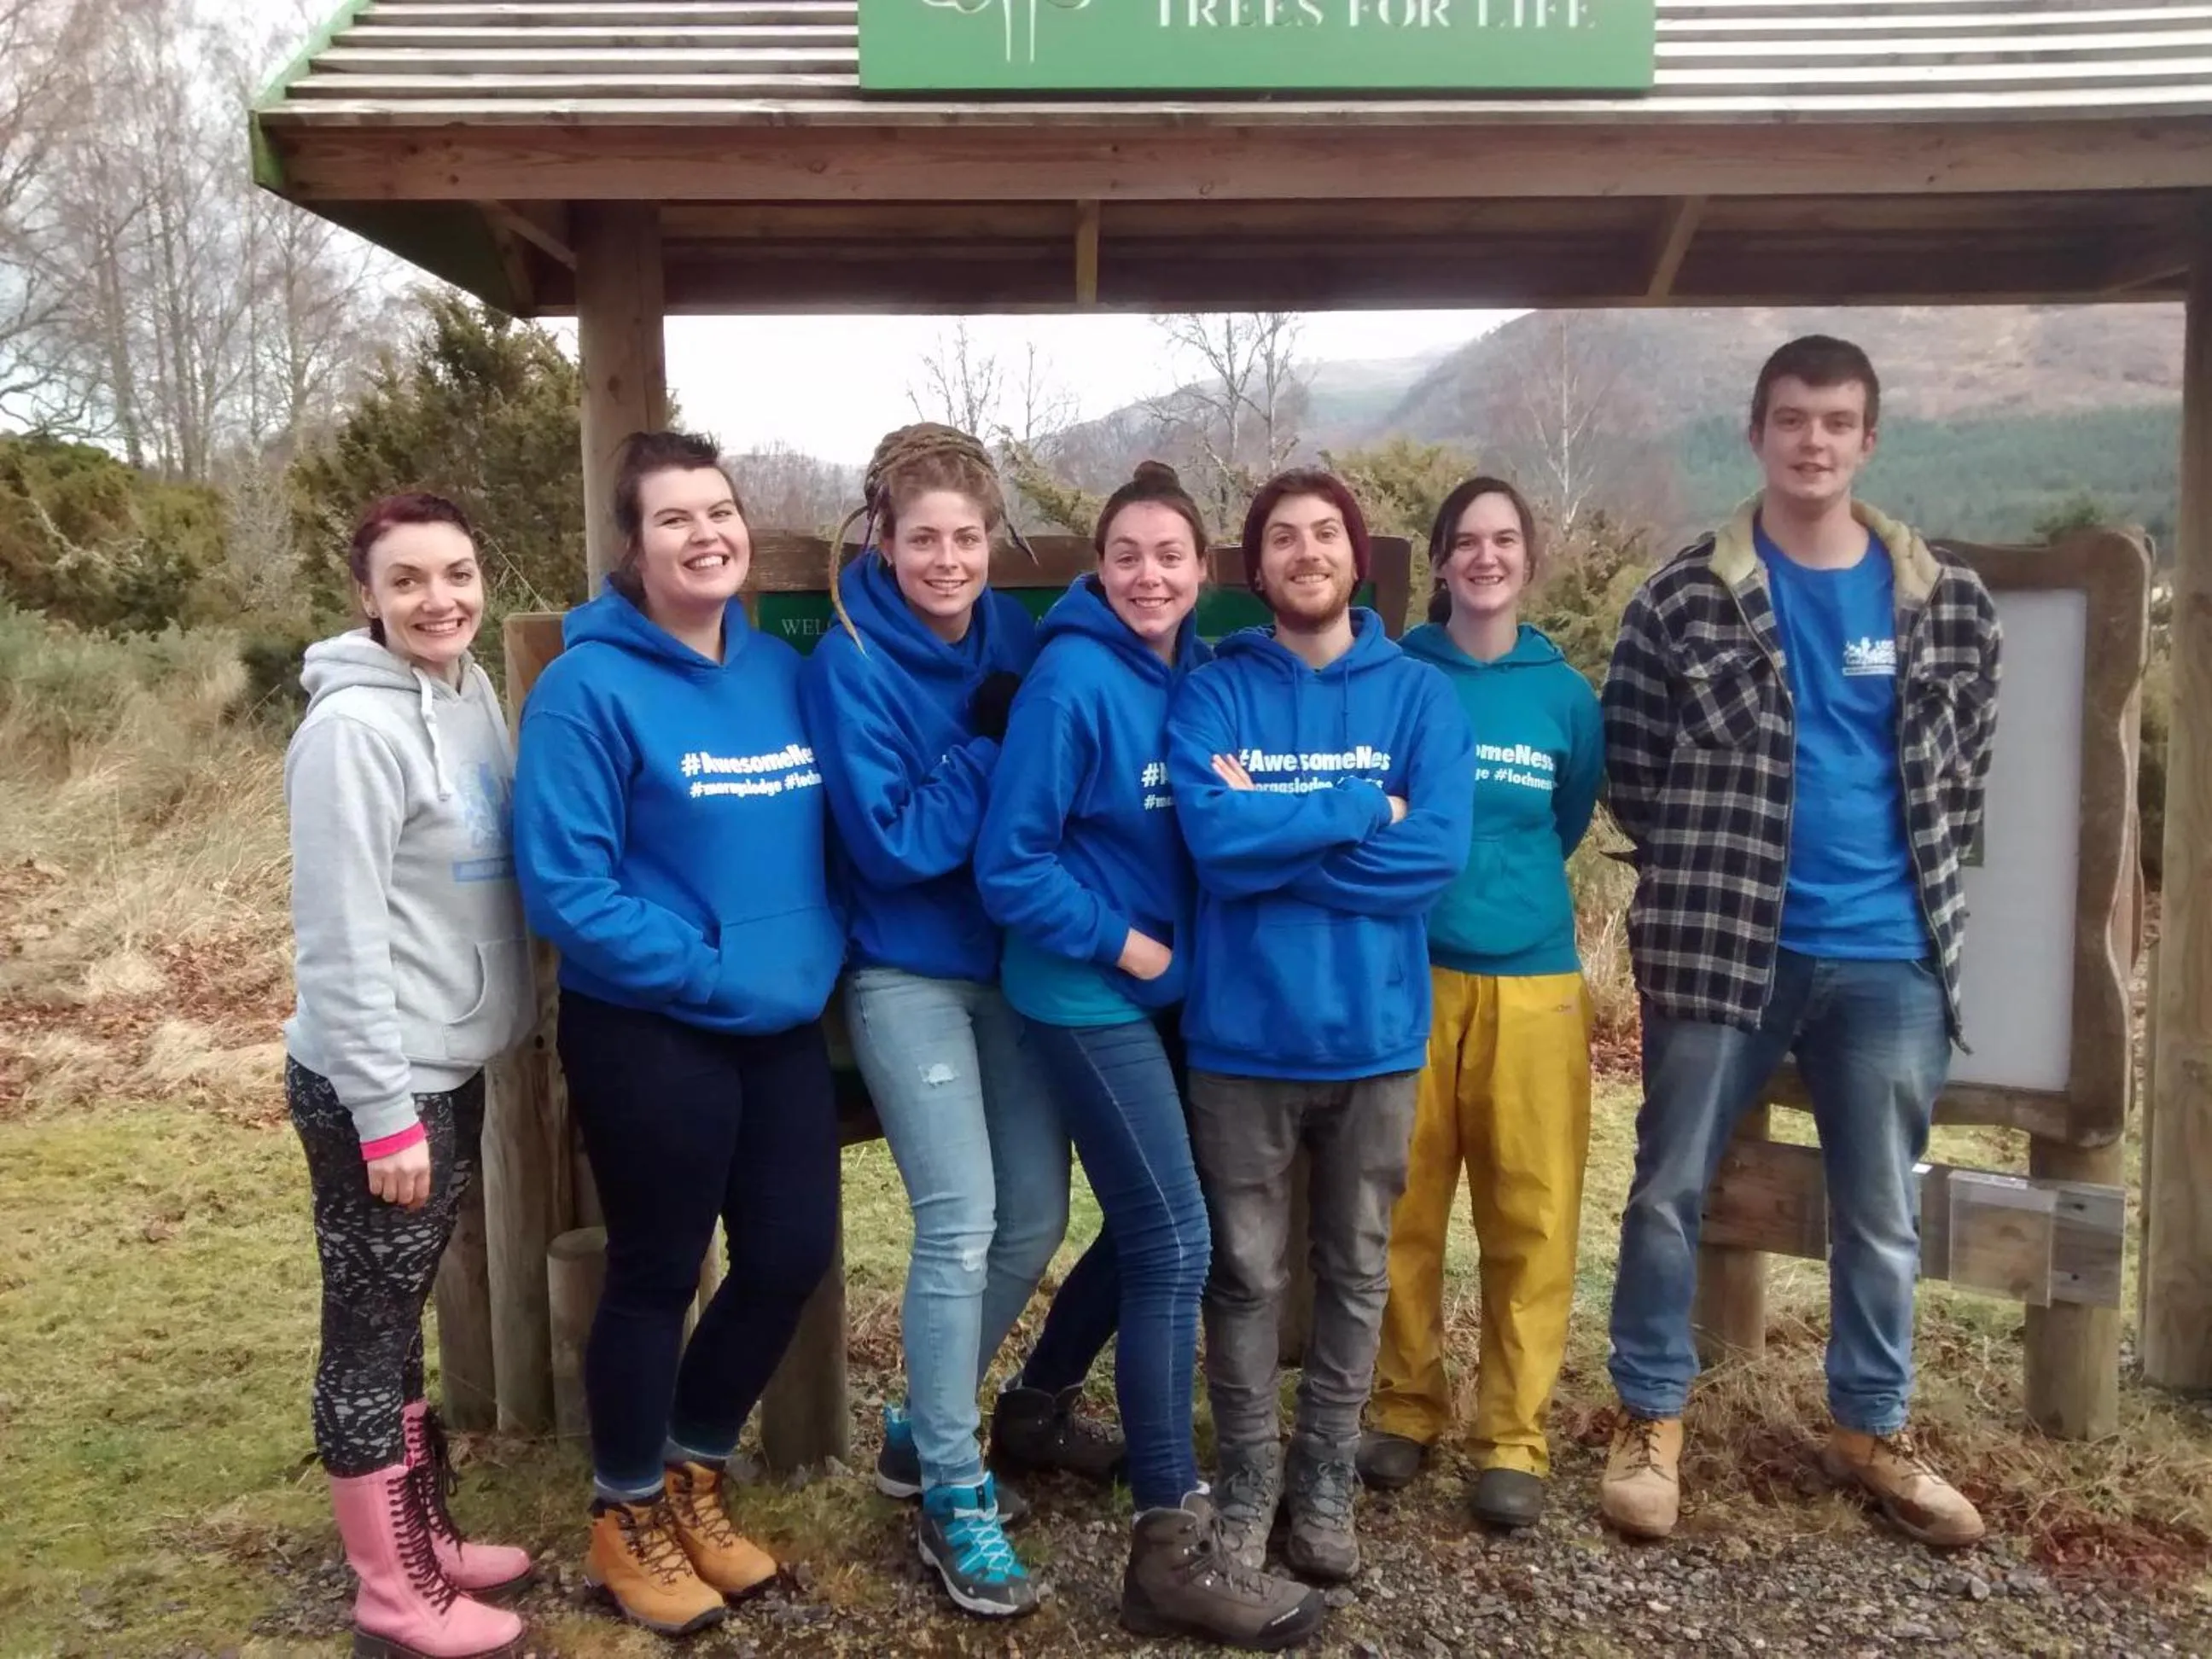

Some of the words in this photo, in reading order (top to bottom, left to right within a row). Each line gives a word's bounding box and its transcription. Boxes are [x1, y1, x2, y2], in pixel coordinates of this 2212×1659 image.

[1158, 0, 1324, 27] TREES
[1348, 0, 1452, 27] FOR
[1478, 0, 1597, 28] LIFE
[781, 618, 827, 637] WEL
